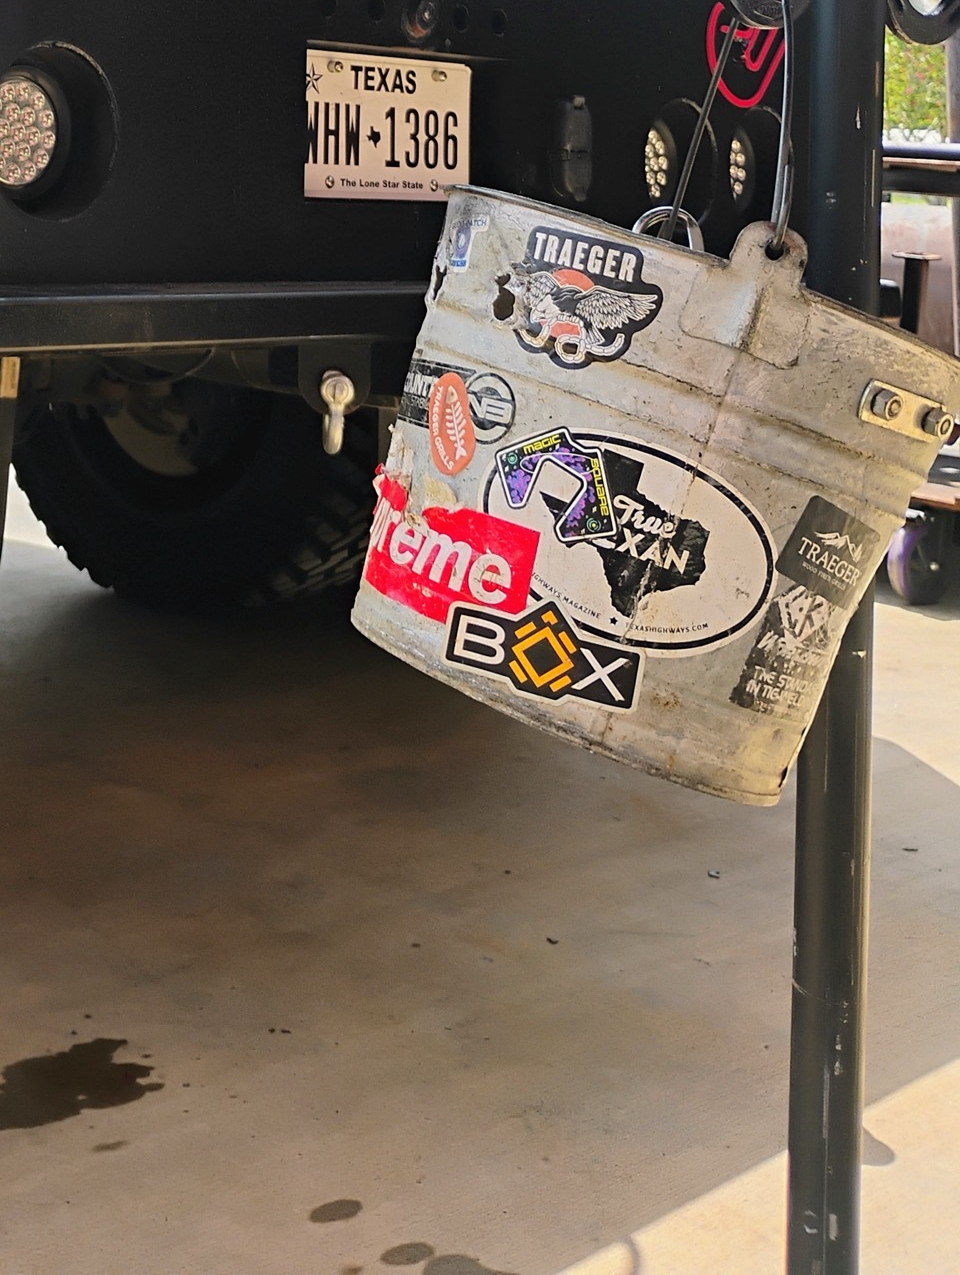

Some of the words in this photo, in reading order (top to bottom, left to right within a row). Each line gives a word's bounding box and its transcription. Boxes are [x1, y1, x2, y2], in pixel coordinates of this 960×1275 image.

[350, 64, 417, 95] TEXAS
[385, 107, 458, 170] 1386
[340, 178, 357, 187] The
[359, 179, 380, 188] Lone
[382, 180, 400, 188] Star
[402, 180, 424, 189] State
[534, 231, 637, 283] TRAEGER
[432, 385, 444, 436] TRAEGER
[434, 436, 455, 471] GRILLS
[613, 494, 677, 538] True
[797, 536, 863, 587] TRAEGER
[563, 595, 601, 619] MAGAZINE
